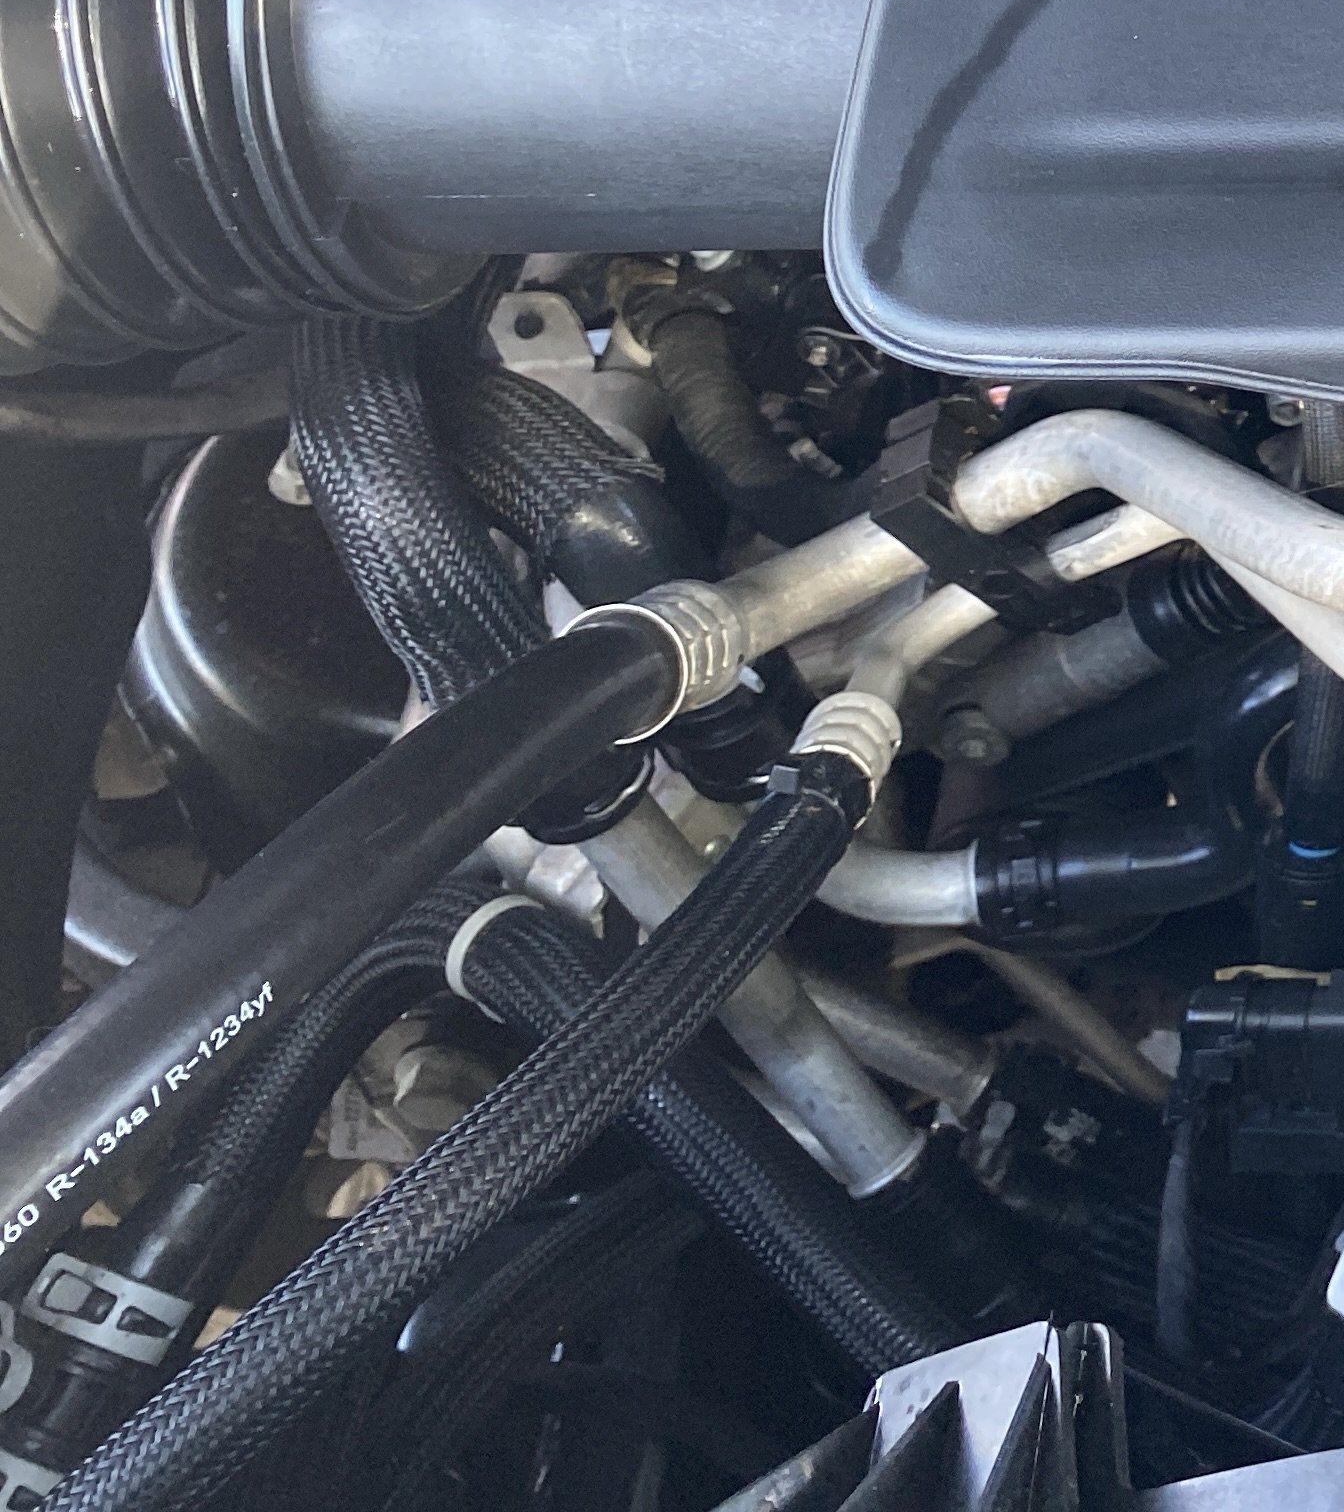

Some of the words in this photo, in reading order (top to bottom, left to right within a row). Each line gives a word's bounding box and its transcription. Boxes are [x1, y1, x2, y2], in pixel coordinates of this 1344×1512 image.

[0, 1203, 39, 1256] 60
[45, 1105, 150, 1201] R-134a
[164, 981, 274, 1092] R-1234yf
